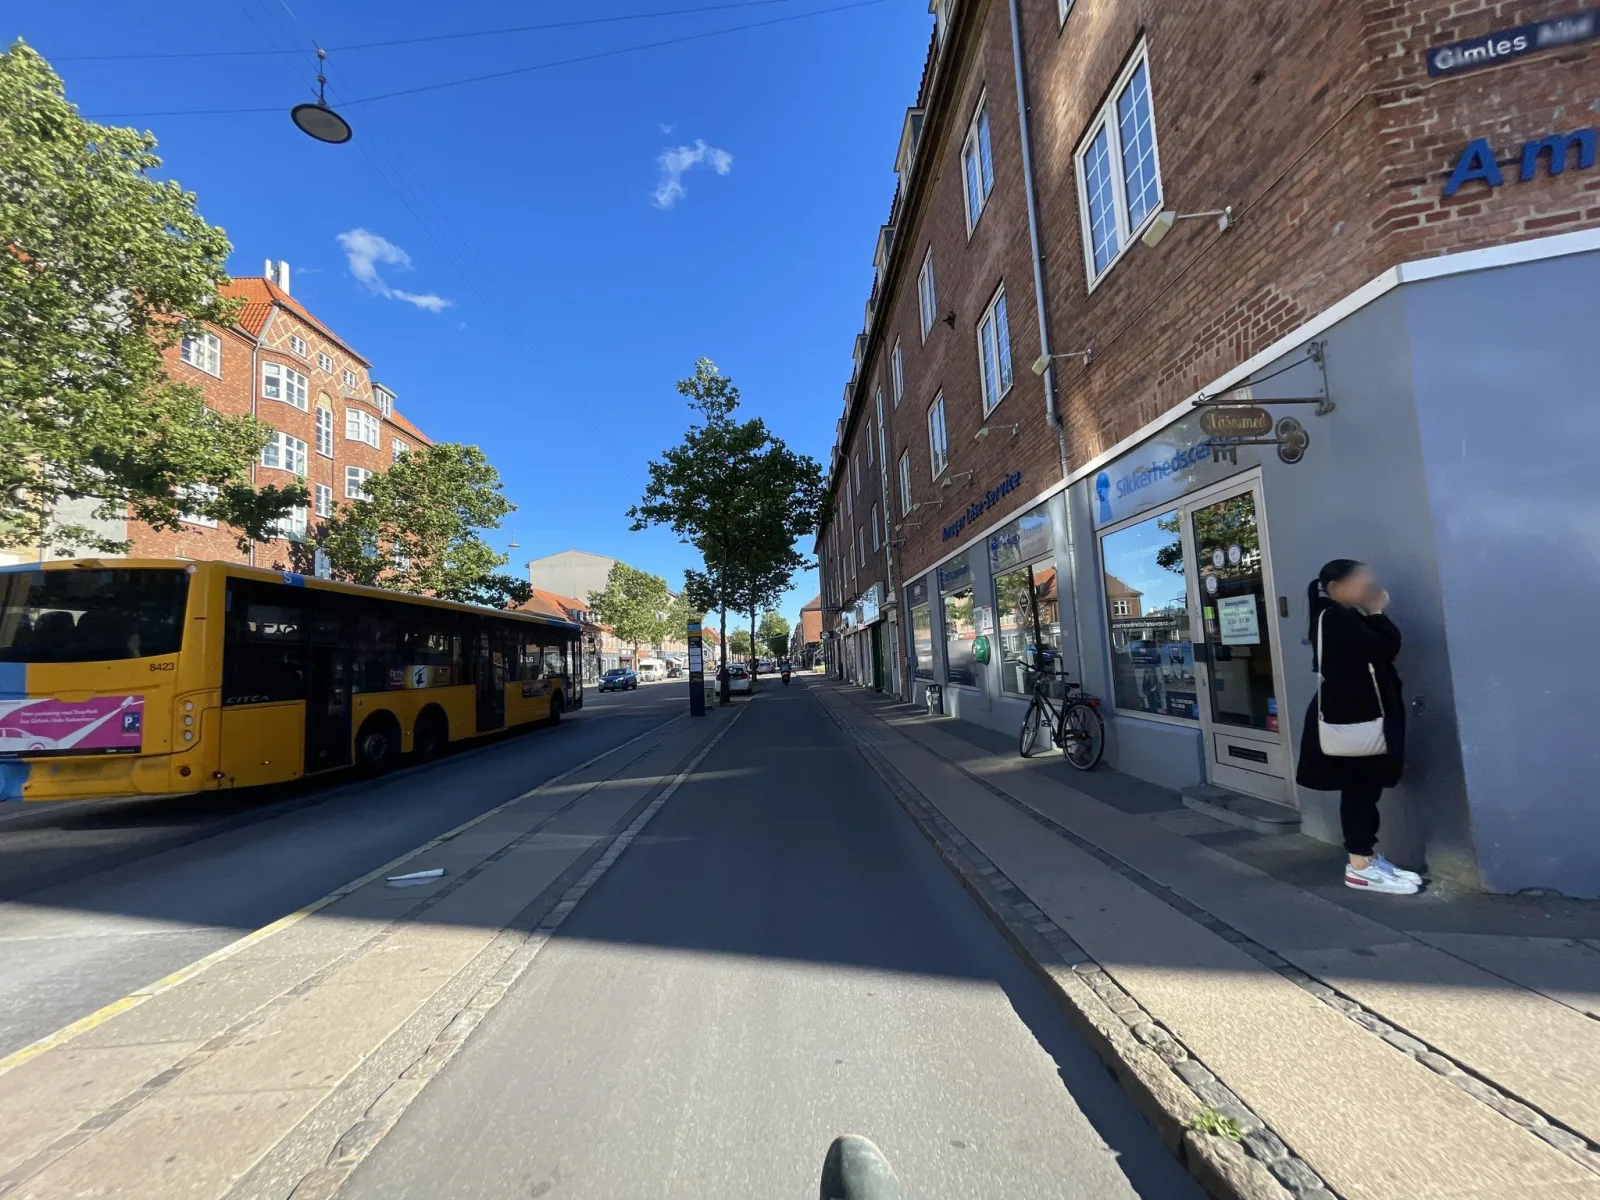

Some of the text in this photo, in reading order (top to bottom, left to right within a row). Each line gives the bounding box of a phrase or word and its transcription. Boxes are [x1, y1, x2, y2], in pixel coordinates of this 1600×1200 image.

[1434, 34, 1528, 70] Gimles
[1442, 128, 1598, 198] Am
[149, 662, 175, 672] 8423
